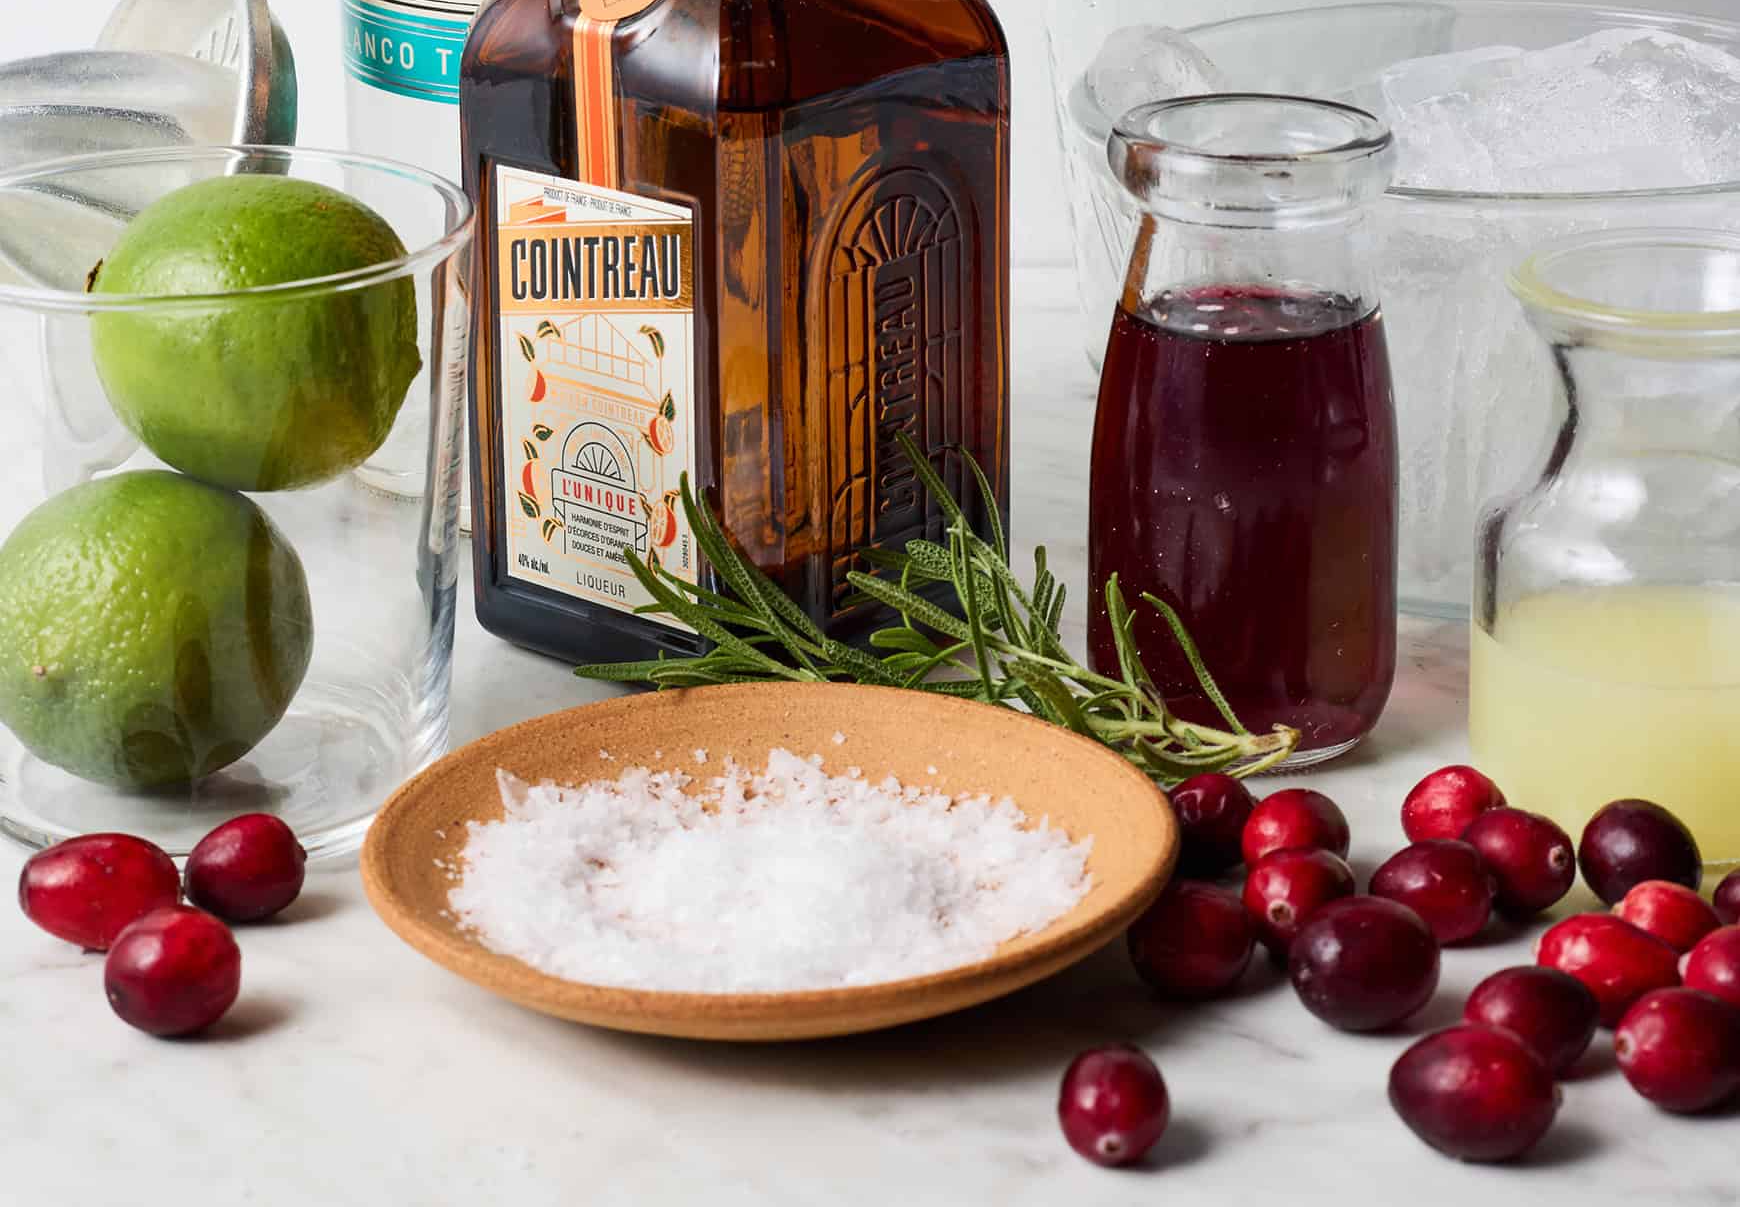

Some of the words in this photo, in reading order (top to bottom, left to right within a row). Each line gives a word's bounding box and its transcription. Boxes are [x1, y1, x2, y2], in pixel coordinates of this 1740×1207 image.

[352, 26, 415, 70] ANCO
[511, 234, 681, 301] COINTREAU
[562, 477, 637, 516] L'UNIQUE
[571, 513, 602, 531] HARMONIE
[603, 522, 630, 539] D'ESPRIT
[571, 540, 596, 555] DOUCES
[596, 547, 605, 558] ET
[605, 550, 630, 565] AMÈRE
[576, 570, 626, 599] LIQUEUR
